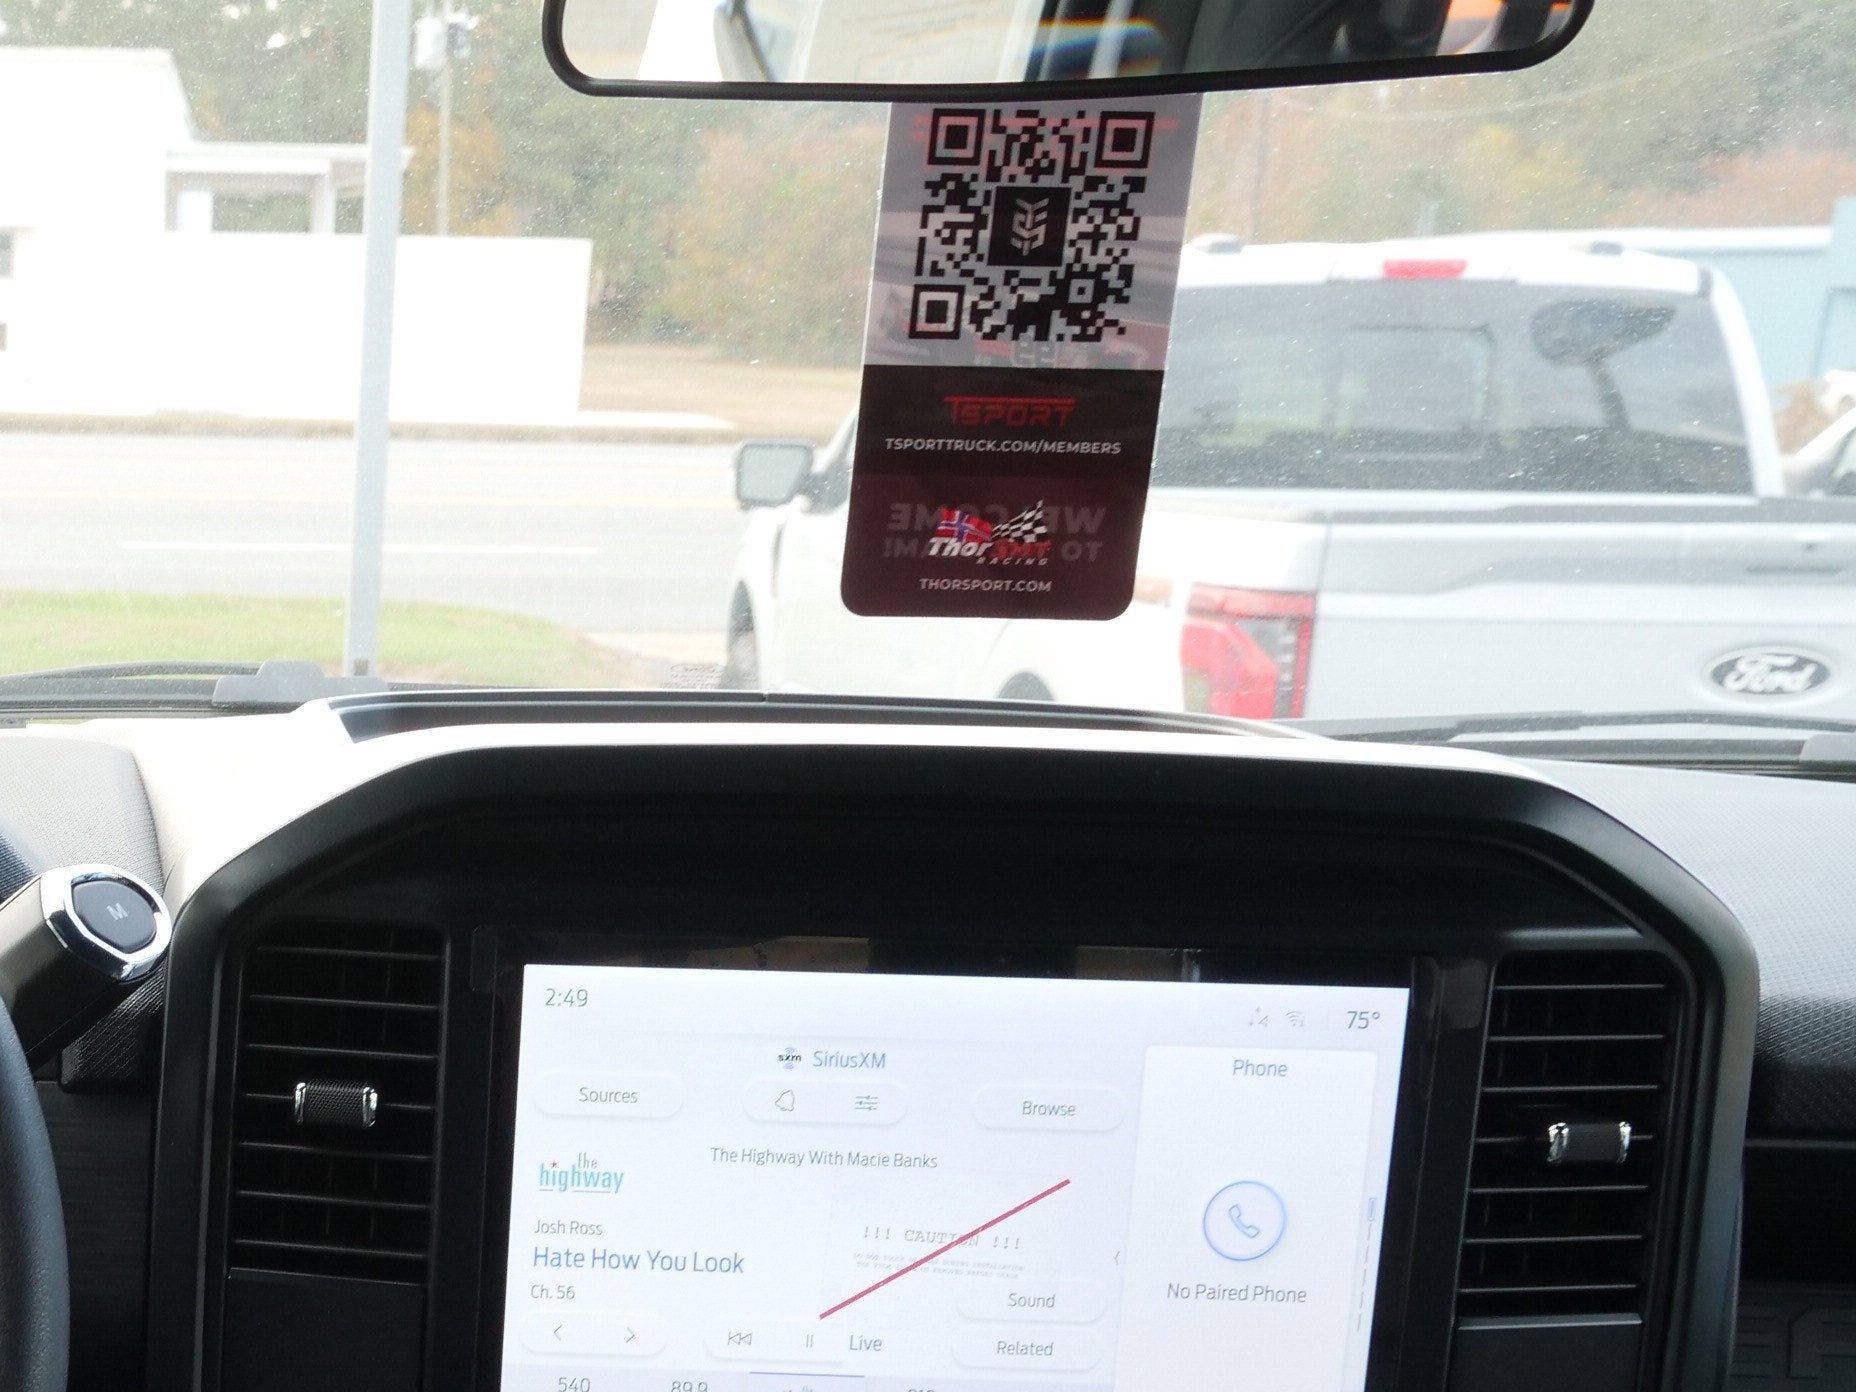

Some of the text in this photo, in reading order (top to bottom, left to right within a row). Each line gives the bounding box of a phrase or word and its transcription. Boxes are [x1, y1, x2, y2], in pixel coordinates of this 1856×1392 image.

[885, 438, 1122, 455] TSPORTTRUCK.COM/MEMBERS
[976, 556, 1048, 566] RACING
[919, 578, 1052, 592] THORSPORT.COM
[544, 987, 589, 1008] 2:49
[812, 1050, 887, 1070] SiriusXM
[1232, 1059, 1288, 1078] Phone
[578, 1086, 638, 1105] Sources
[1021, 1100, 1076, 1118] Browse
[577, 1153, 598, 1170] the
[710, 1148, 938, 1169] The Highway With Macie Banks
[538, 1163, 624, 1194] highway
[534, 1220, 603, 1236] Josh Ross
[533, 1246, 744, 1273] Hate How You Look
[531, 1284, 575, 1300] Ch. 56
[1008, 1292, 1056, 1309] Sound
[1167, 1283, 1307, 1303] No Paired Phone
[849, 1334, 883, 1353] Live
[996, 1340, 1053, 1358] Related
